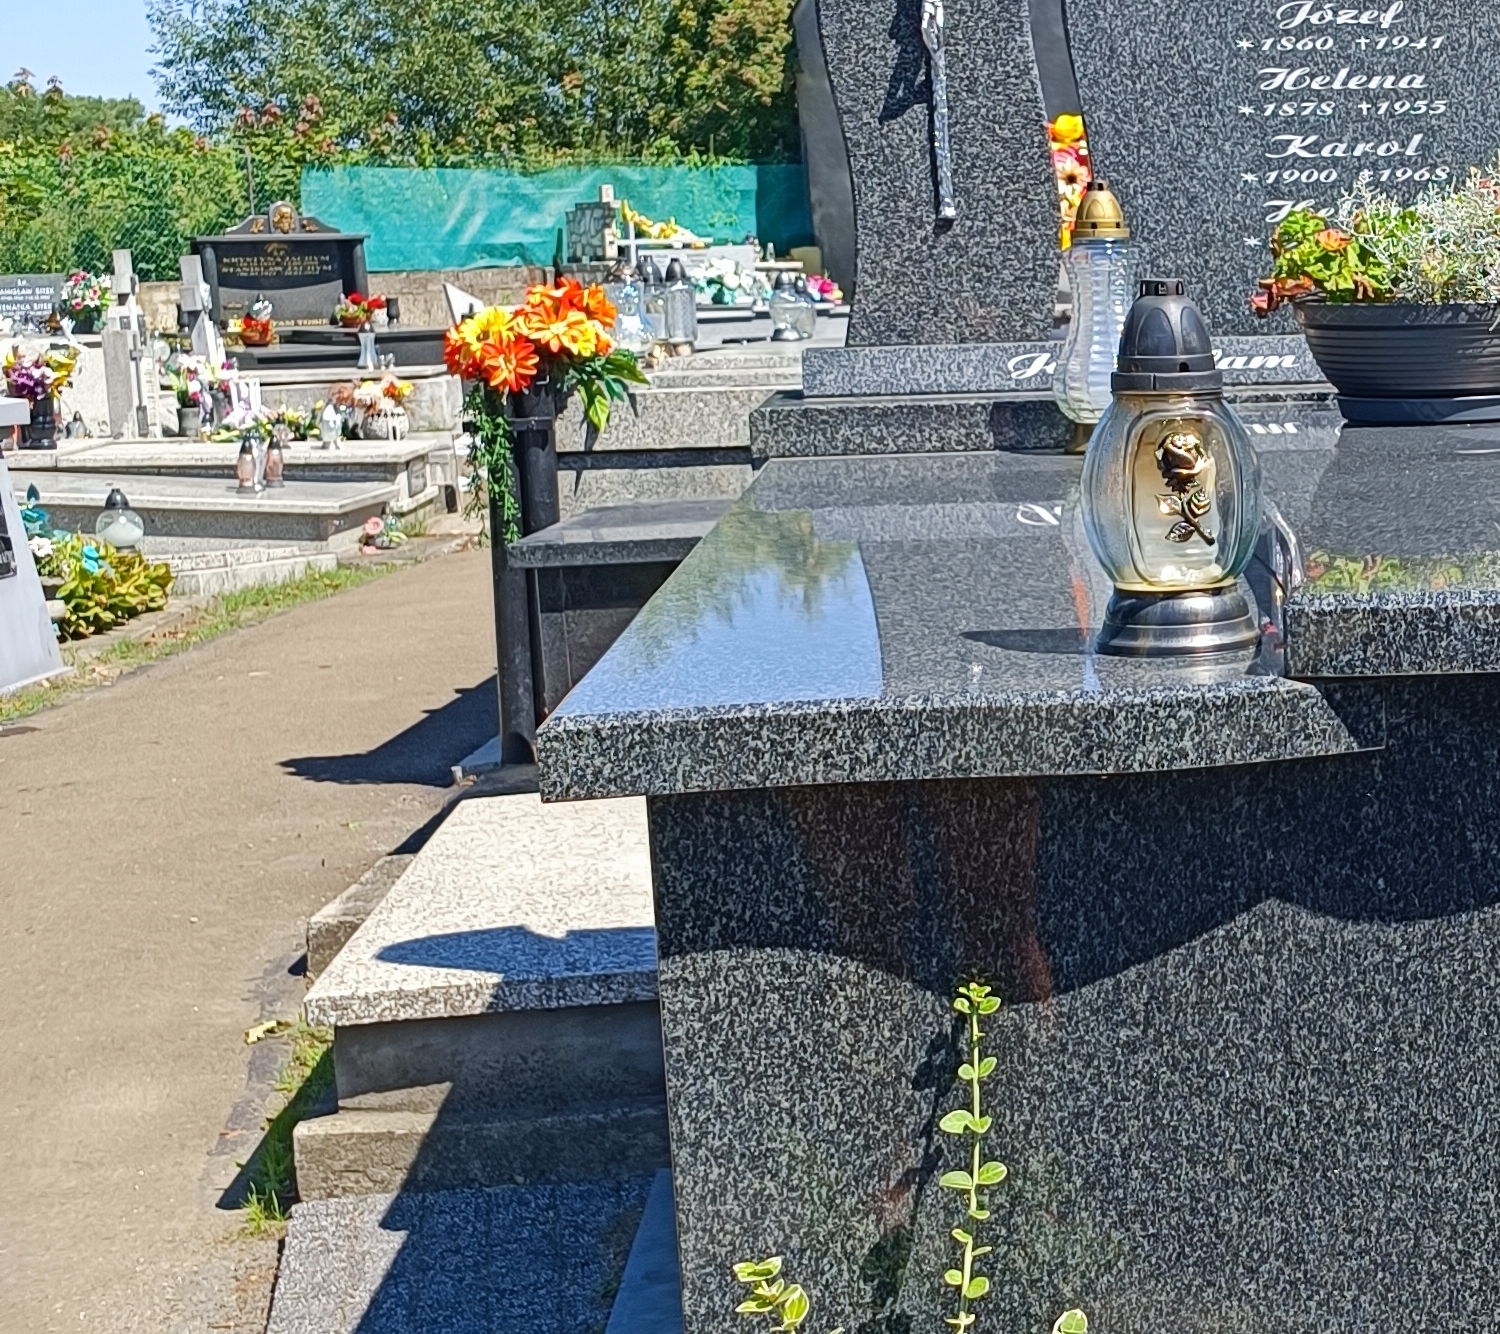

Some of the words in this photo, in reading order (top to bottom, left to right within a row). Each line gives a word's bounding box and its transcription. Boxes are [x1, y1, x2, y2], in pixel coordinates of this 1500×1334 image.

[1276, 0, 1405, 29] Józef
[1258, 67, 1429, 90] Helena
[1265, 133, 1423, 158] Karol
